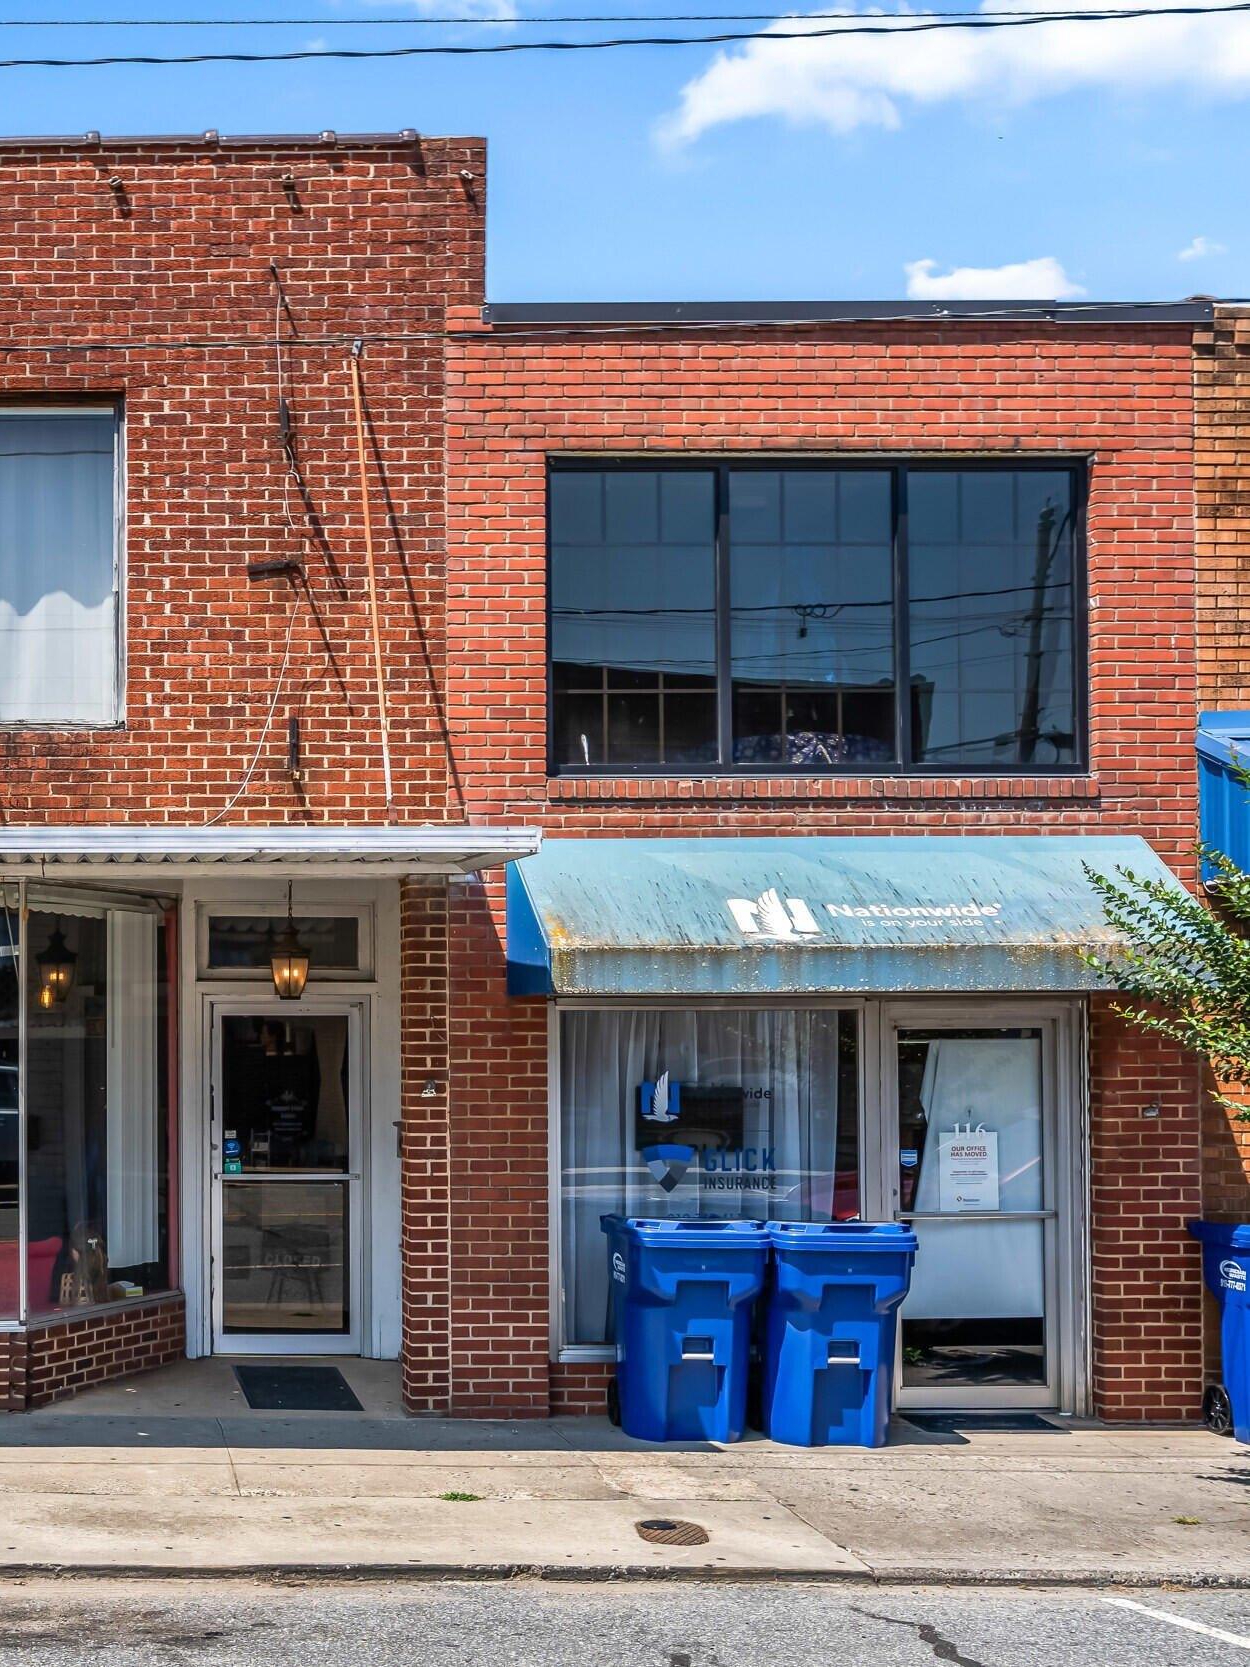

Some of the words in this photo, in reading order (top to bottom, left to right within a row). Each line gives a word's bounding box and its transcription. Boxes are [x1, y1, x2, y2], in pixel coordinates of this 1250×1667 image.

[862, 918, 876, 927] is
[880, 919, 900, 927] on
[905, 919, 943, 928] your
[950, 918, 983, 927] side
[952, 1122, 986, 1139] 116
[704, 1176, 777, 1190] INSURANCE
